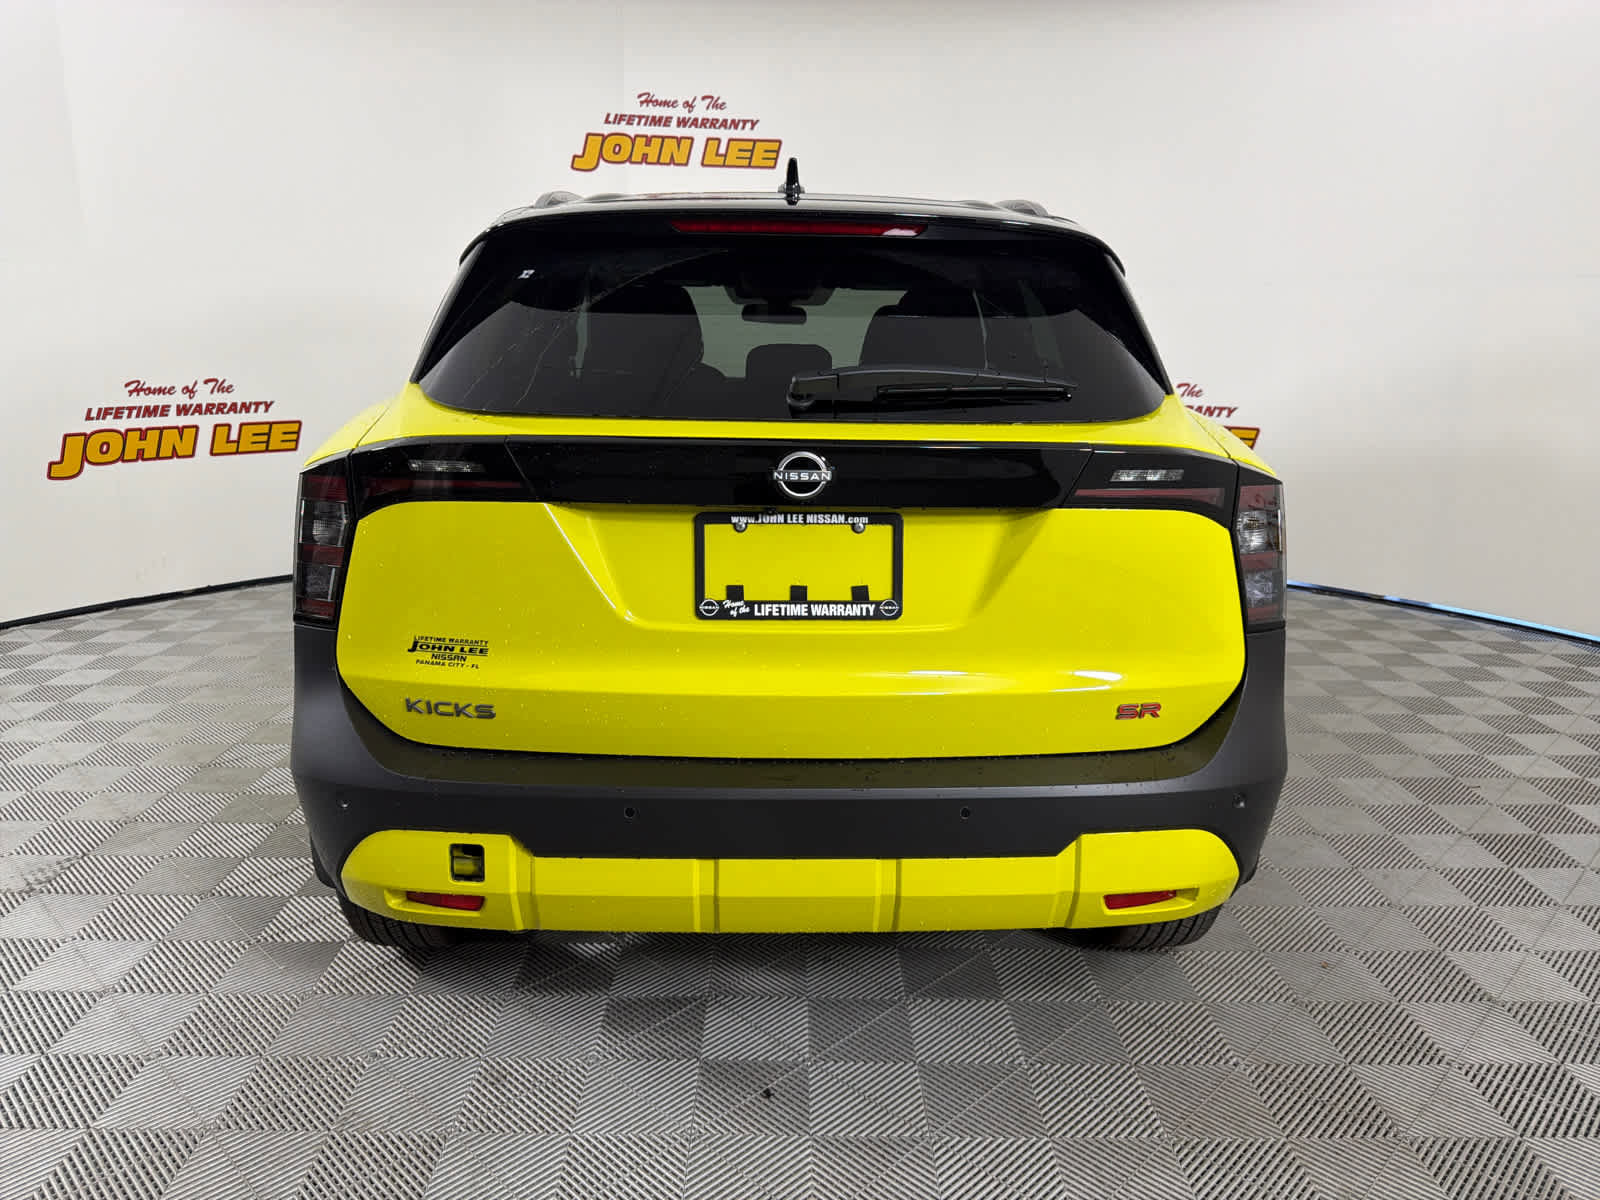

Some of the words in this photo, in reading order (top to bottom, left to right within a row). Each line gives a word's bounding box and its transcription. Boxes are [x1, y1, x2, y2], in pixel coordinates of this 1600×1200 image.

[637, 92, 678, 109] Home
[683, 96, 696, 113] of
[701, 95, 727, 110] The
[604, 113, 673, 127] LIFETIME
[676, 116, 759, 130] WARRANTY
[571, 133, 694, 171] JOHN
[701, 138, 782, 169] LEE
[124, 380, 176, 397] Home
[182, 380, 198, 399] of
[203, 378, 234, 395] The
[1176, 382, 1203, 398] The
[85, 404, 171, 421] LIFETIME
[175, 401, 274, 417] WARRANTY
[47, 425, 199, 480] JOHN
[210, 420, 302, 456] LEE
[773, 471, 832, 481] NISSAN
[787, 514, 804, 524] LEE
[806, 514, 868, 524] NISSAN.com
[723, 600, 744, 609] Home
[754, 604, 808, 616] LIFETIME
[811, 604, 875, 616] WARRANTY
[730, 607, 738, 618] of
[408, 640, 455, 653] JOHN
[460, 646, 489, 655] LEE
[414, 635, 446, 643] LIFETIME
[449, 638, 488, 647] WARRANTY
[416, 659, 446, 667] PANAMA
[431, 653, 467, 662] NISSAN
[405, 697, 496, 719] KICKS
[1115, 702, 1162, 720] SR
